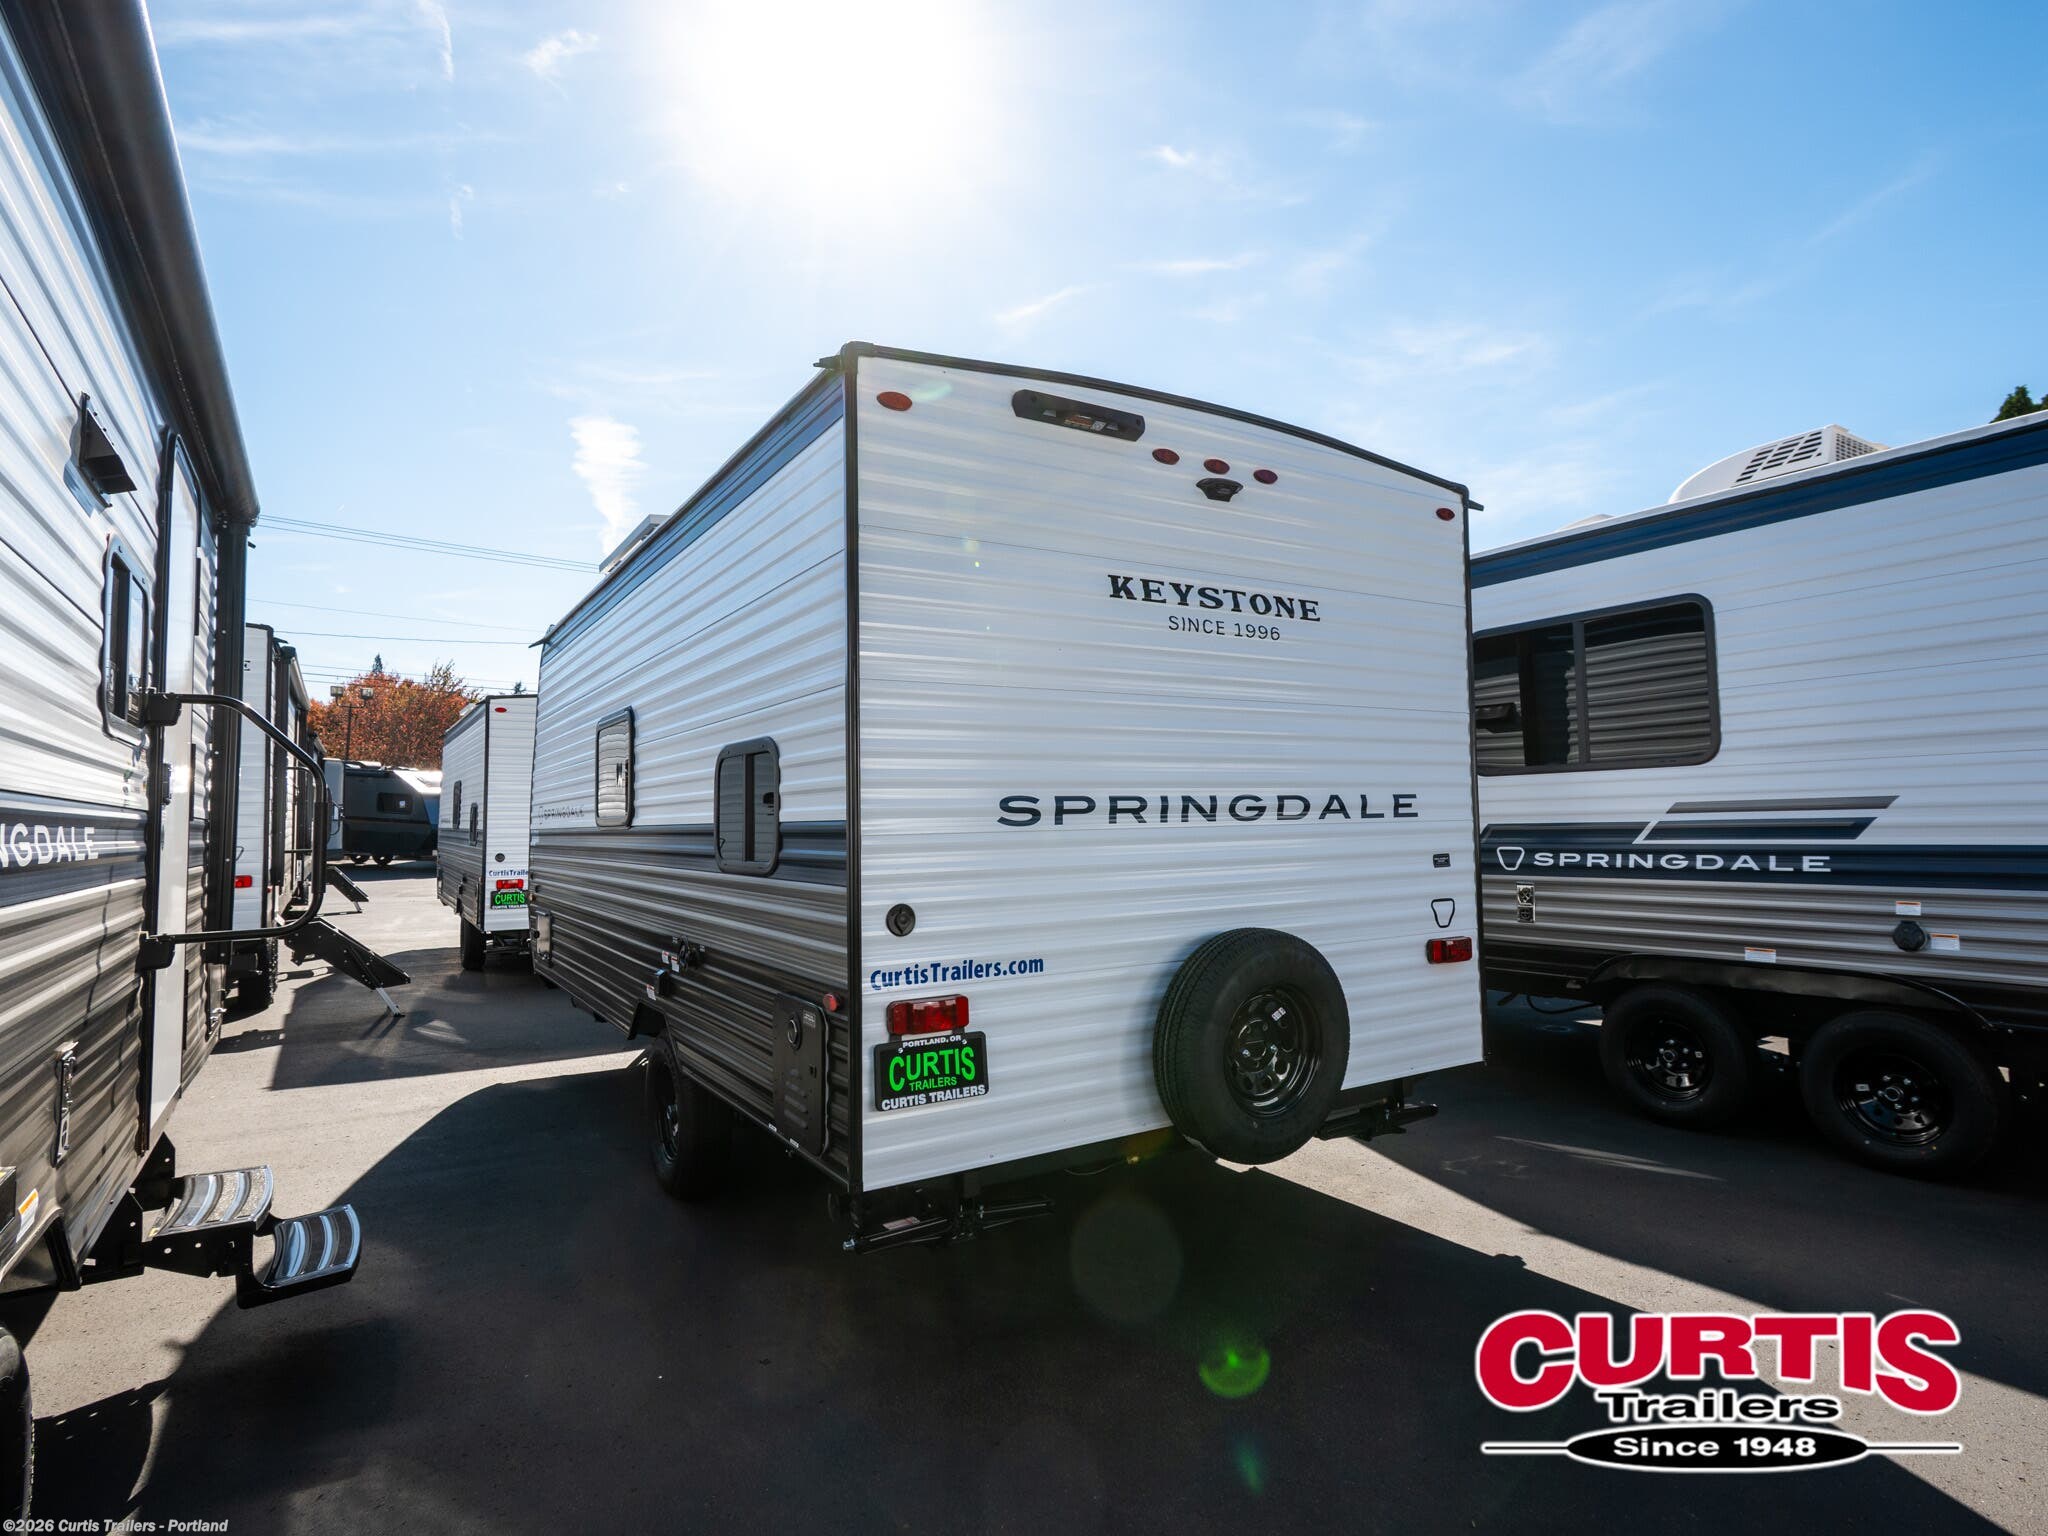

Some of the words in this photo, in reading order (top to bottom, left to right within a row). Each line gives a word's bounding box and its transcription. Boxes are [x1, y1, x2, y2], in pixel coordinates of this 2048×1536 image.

[1107, 574, 1321, 622] KEYSTONE
[1168, 615, 1226, 636] SINCE
[1234, 623, 1281, 641] 1996
[997, 793, 1419, 828] SPRINGDALE
[1533, 852, 1832, 873] SPRINGDALE
[494, 893, 526, 905] CURTIS
[870, 958, 1044, 990] CurtisTrailers.com
[950, 1034, 962, 1042] OR
[889, 1046, 976, 1092] CURTIS
[909, 1076, 958, 1092] TRAILERS
[881, 1093, 927, 1111] CURTIS
[929, 1084, 986, 1104] TRAILERS
